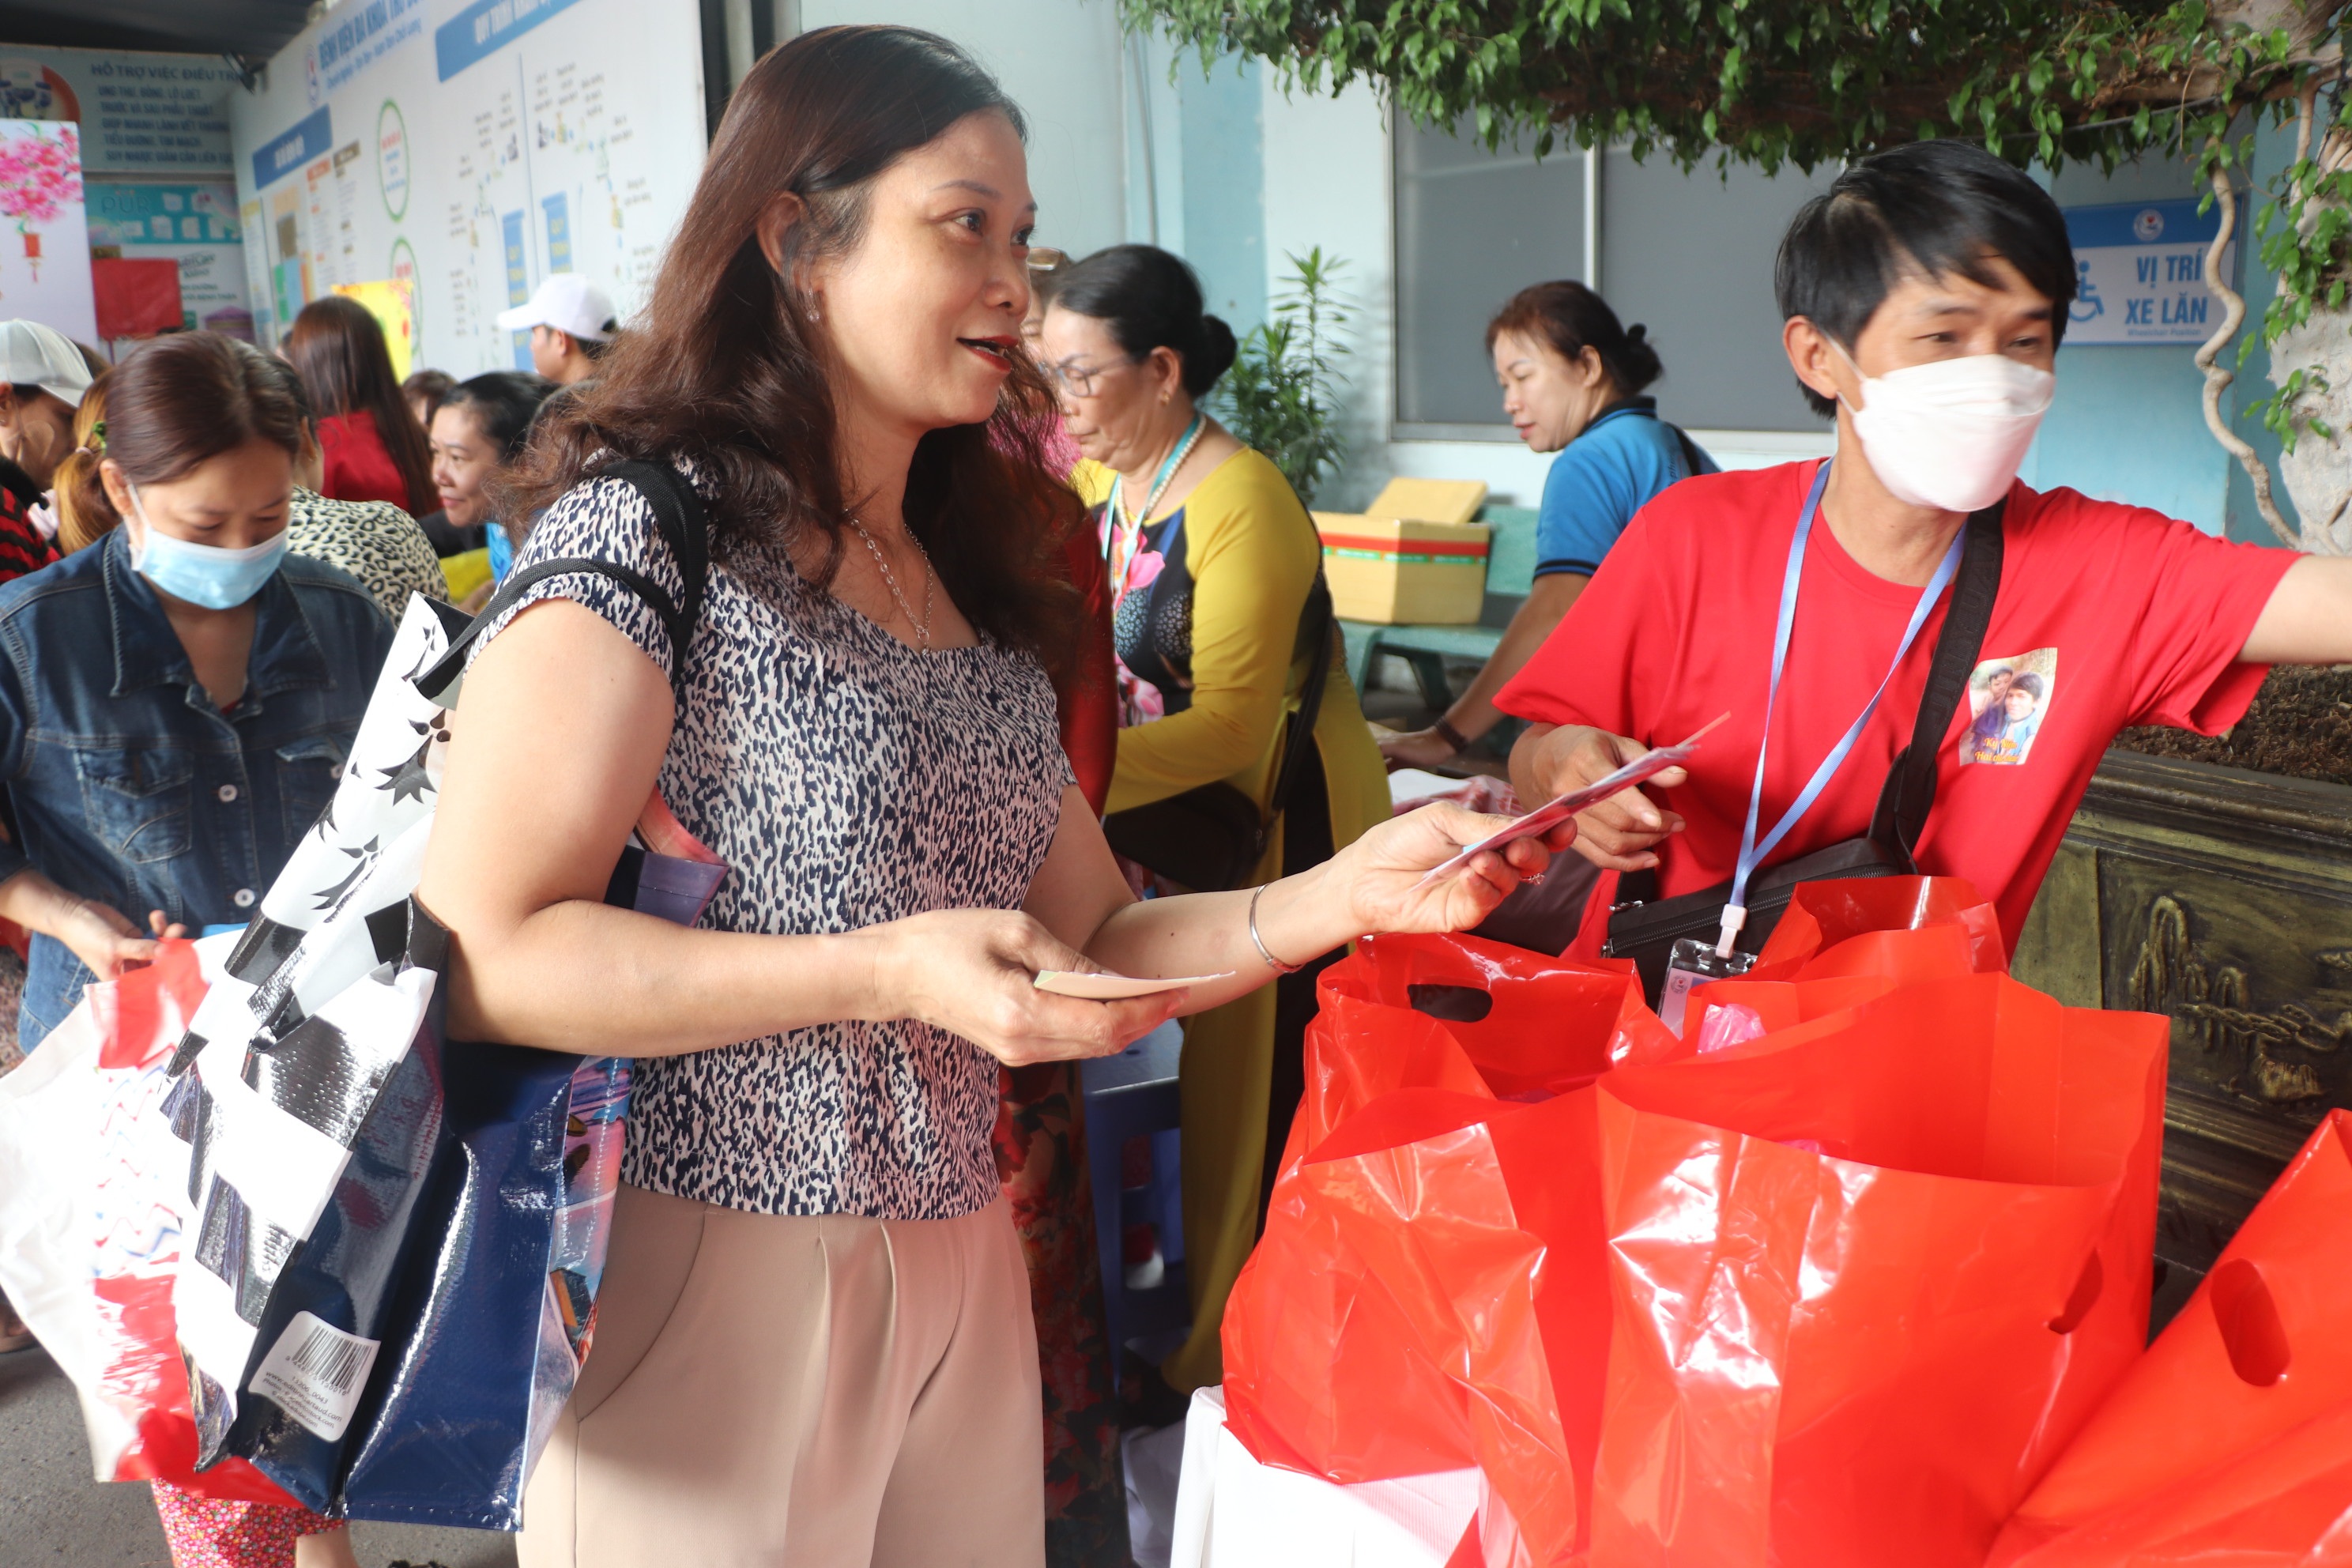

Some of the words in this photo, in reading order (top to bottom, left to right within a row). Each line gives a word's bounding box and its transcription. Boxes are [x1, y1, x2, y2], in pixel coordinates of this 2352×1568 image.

[2137, 255, 2158, 288] VỊ
[2165, 247, 2203, 282] TRÍ
[2125, 298, 2154, 325] XE
[2162, 291, 2208, 325] LĂN
